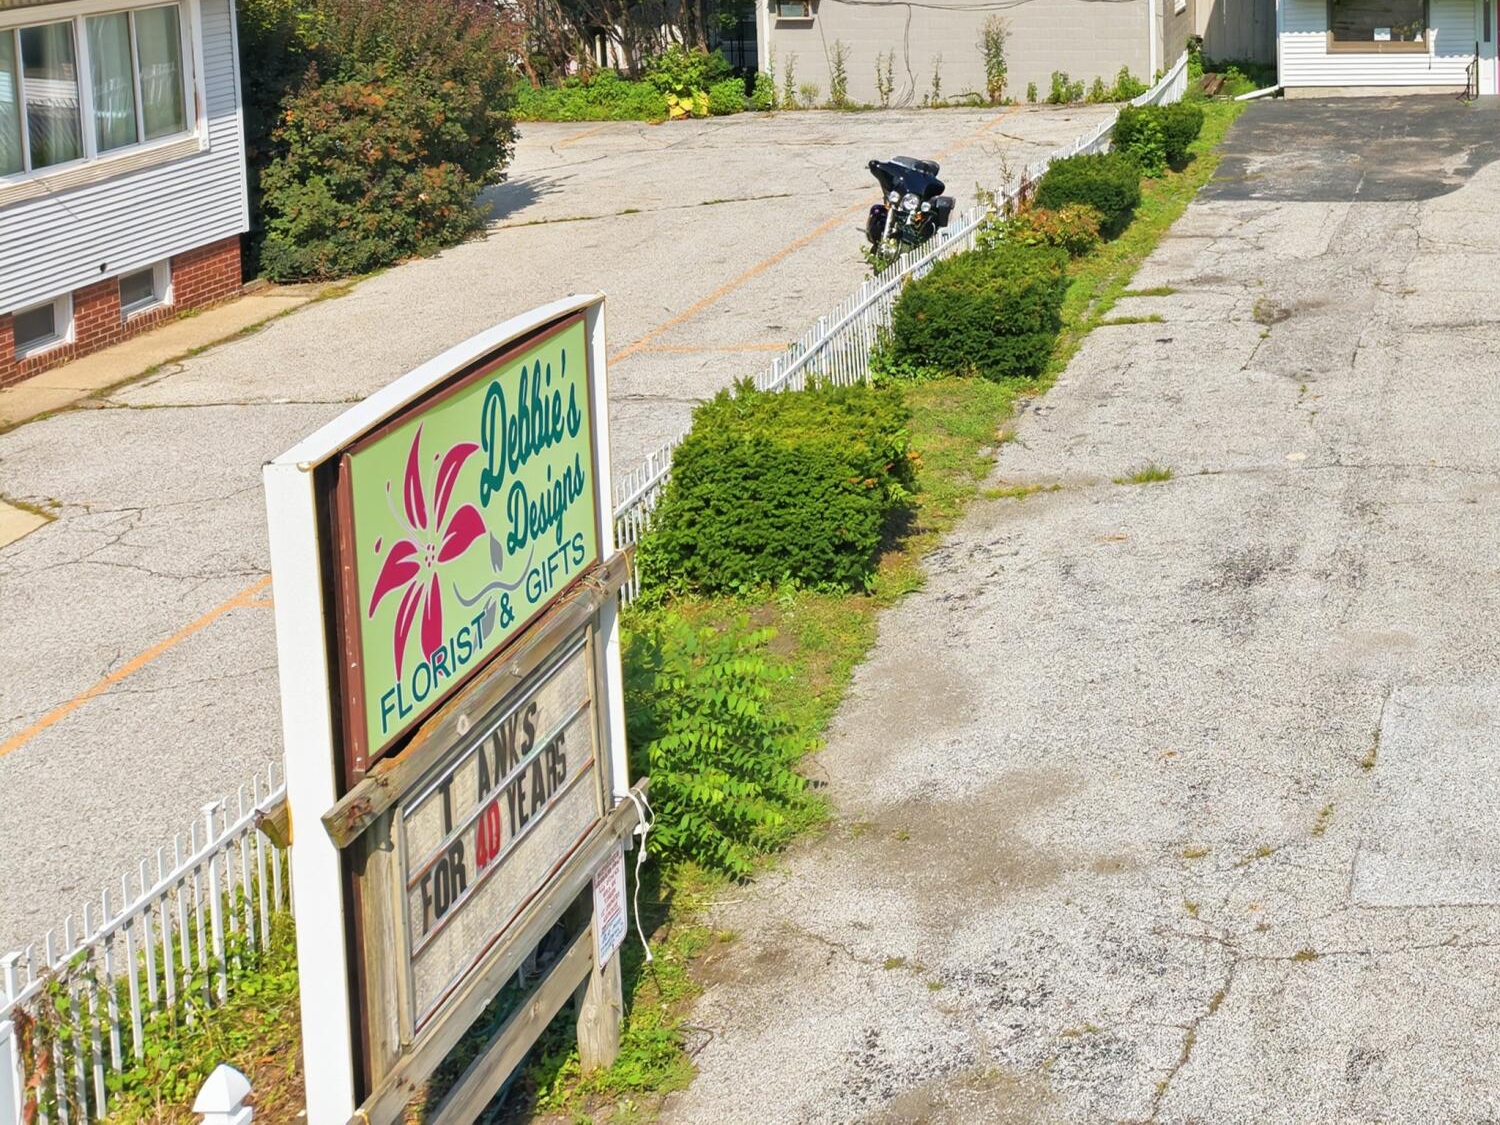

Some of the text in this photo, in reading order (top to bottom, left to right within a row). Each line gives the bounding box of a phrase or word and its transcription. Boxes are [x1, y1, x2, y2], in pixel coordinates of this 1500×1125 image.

[480, 348, 582, 508] Debbie's
[506, 452, 585, 556] Designs
[380, 532, 585, 734] FLORIST & GIFTS
[419, 839, 467, 937] FOR
[506, 731, 567, 839] YEARS
